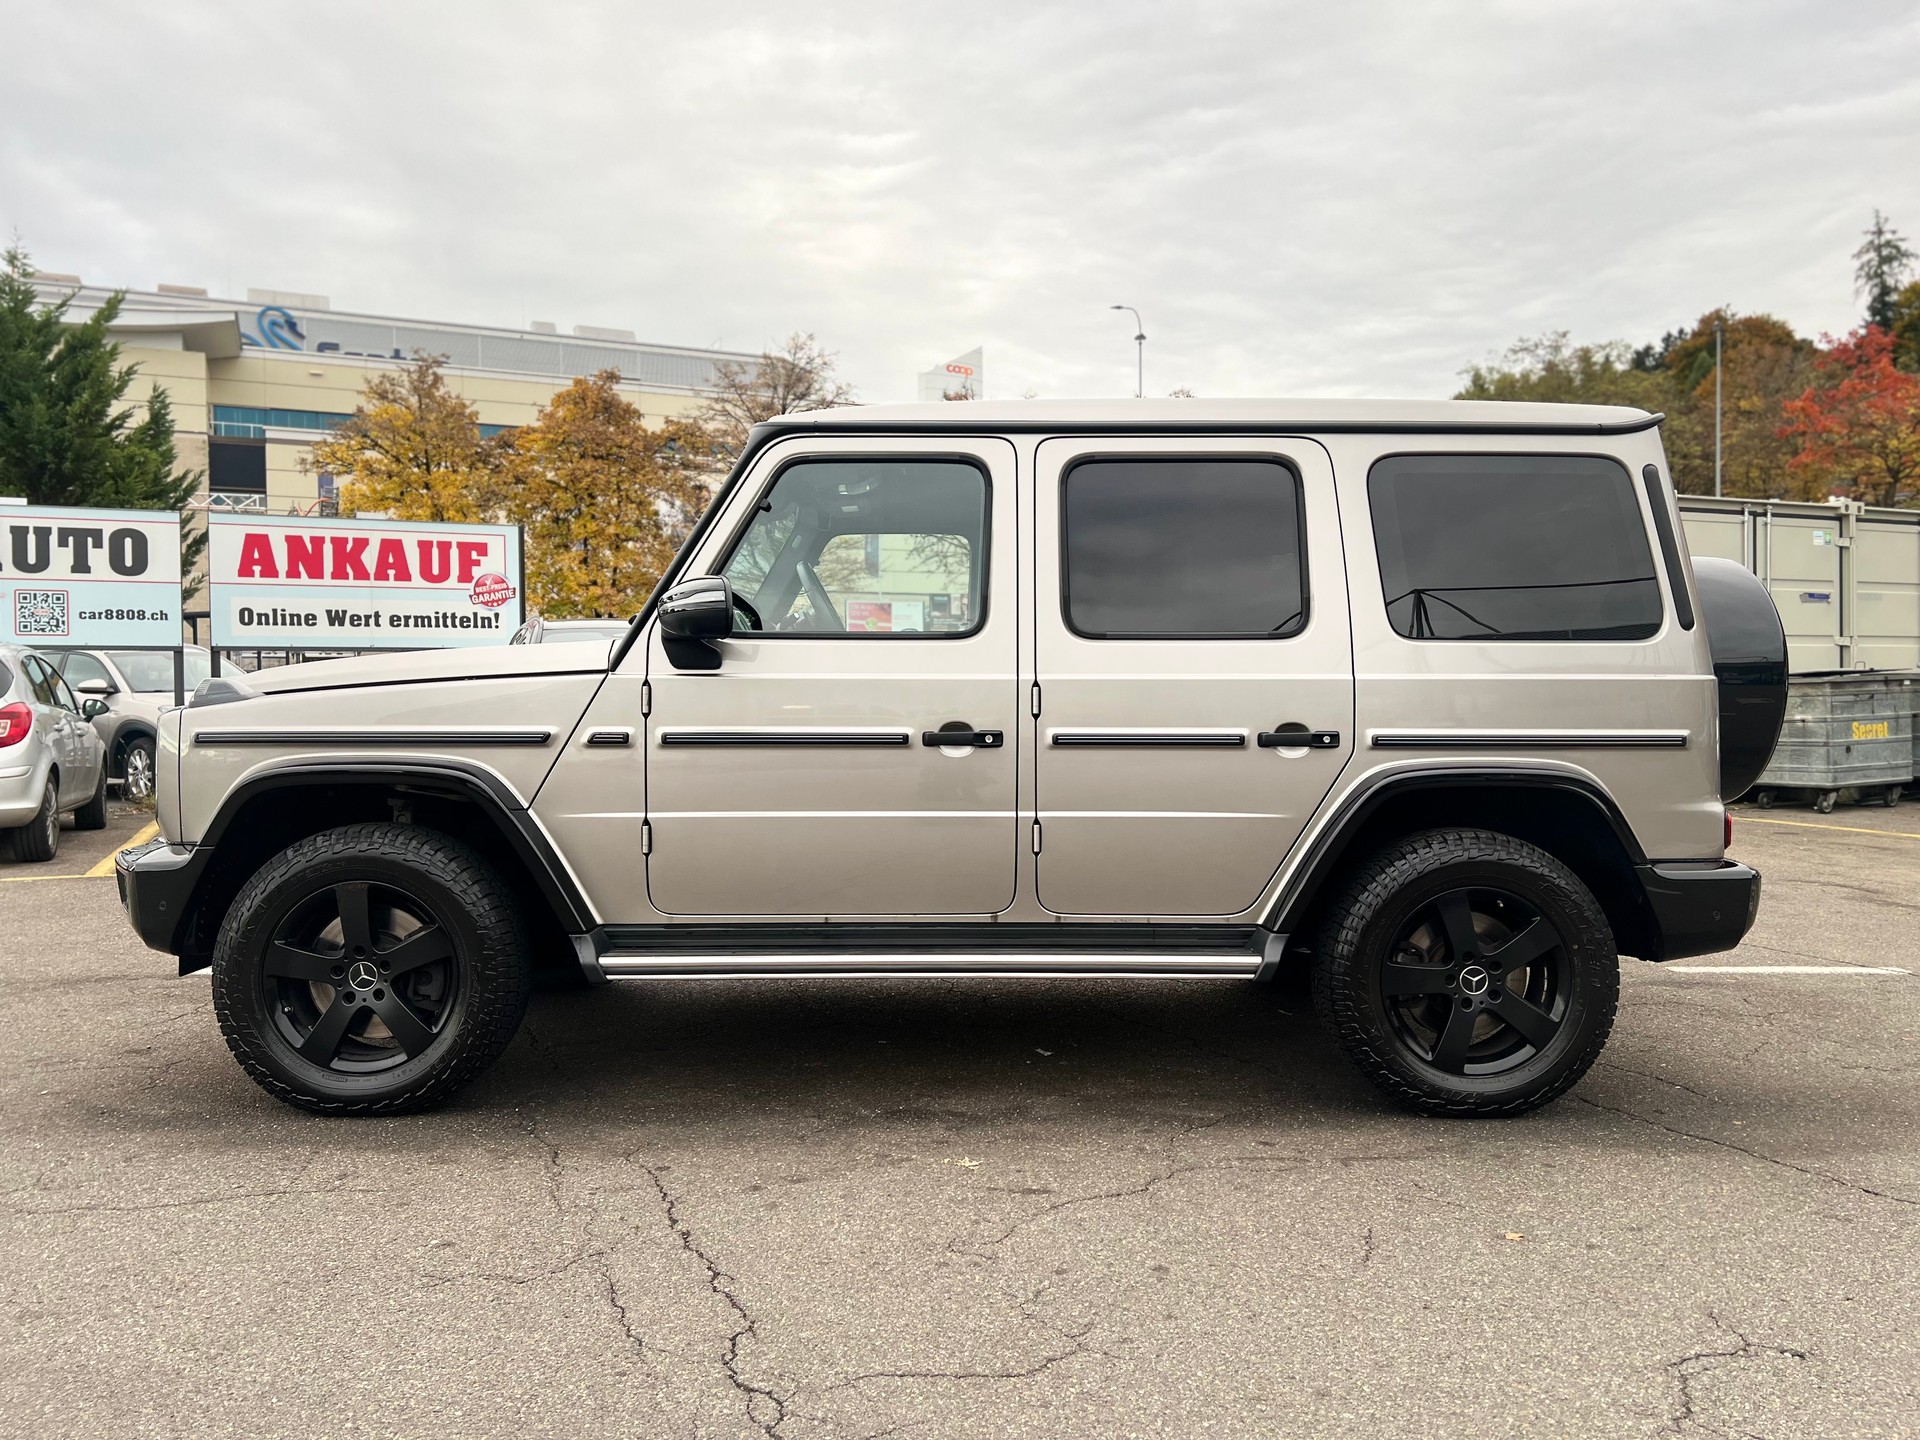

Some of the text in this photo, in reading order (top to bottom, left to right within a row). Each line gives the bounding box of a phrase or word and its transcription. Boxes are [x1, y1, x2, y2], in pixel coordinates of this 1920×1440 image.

[946, 364, 973, 377] coop
[0, 525, 149, 577] UTO
[237, 533, 488, 584] ANKAUF
[471, 588, 515, 604] GARANTIE
[78, 609, 169, 621] car8808.ch
[238, 607, 500, 629] Online Wert ermitteln!
[1852, 721, 1889, 739] Secret
